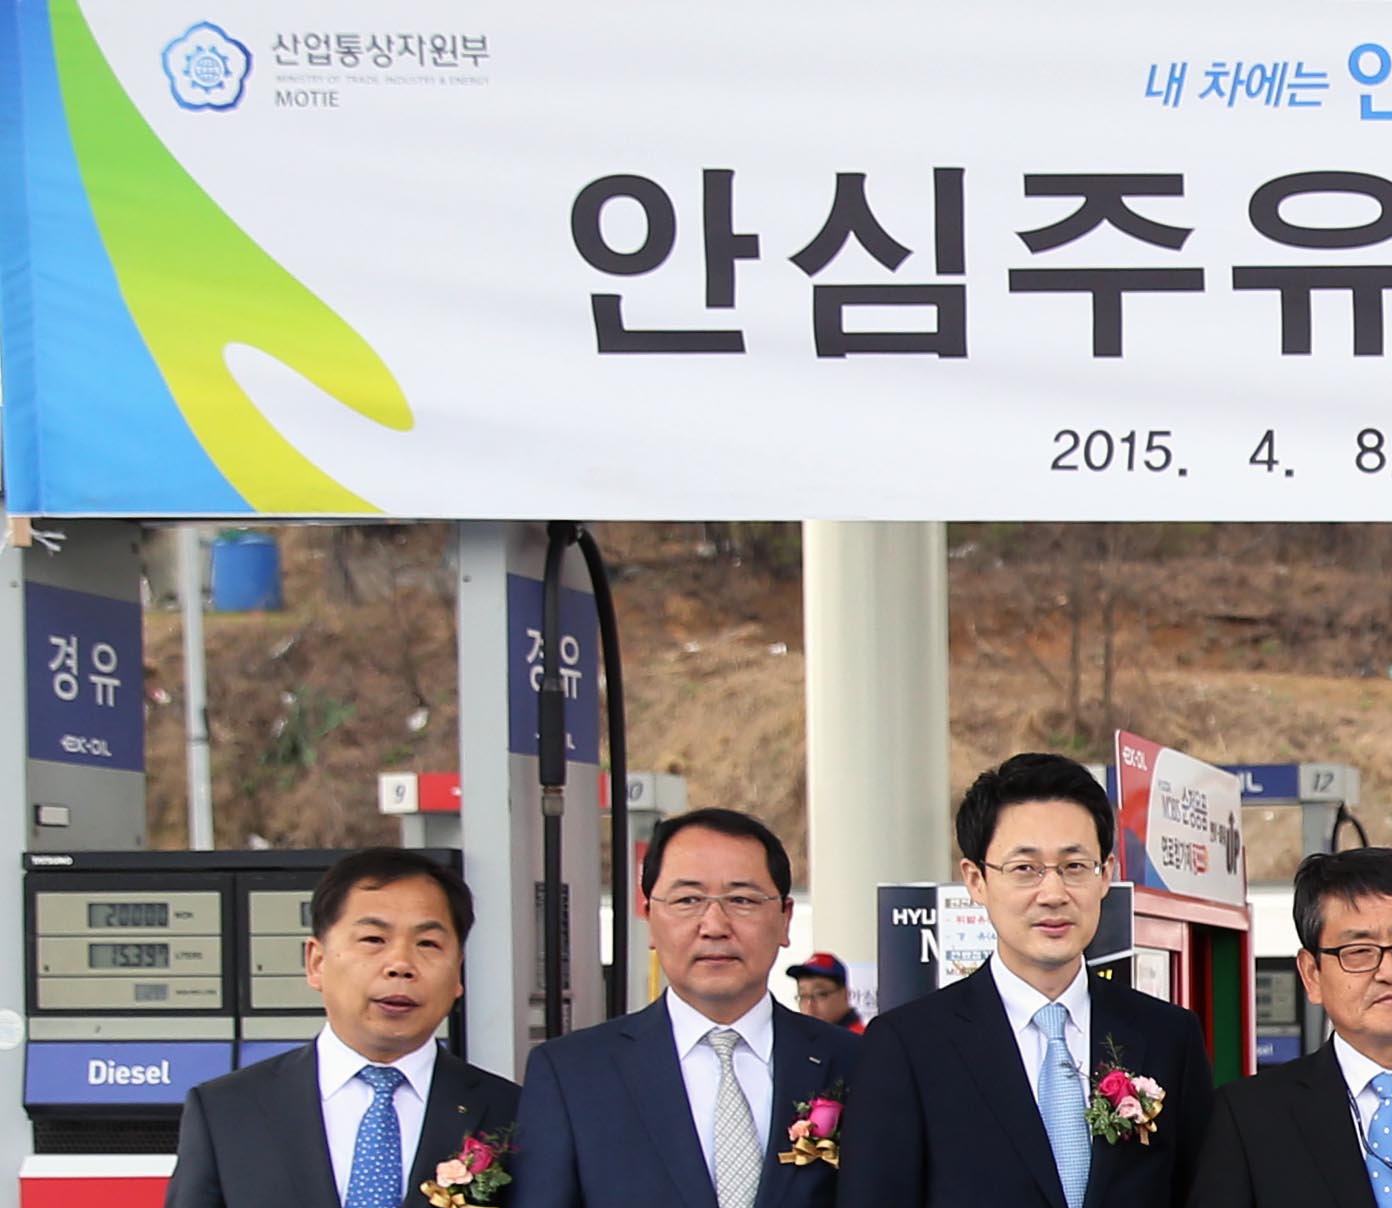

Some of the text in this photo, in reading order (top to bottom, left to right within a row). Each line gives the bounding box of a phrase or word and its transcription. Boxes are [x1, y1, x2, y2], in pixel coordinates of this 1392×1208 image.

[272, 33, 489, 68] 산업통상자원부
[274, 90, 339, 107] MOTIE
[1145, 62, 1187, 107] 내
[1199, 62, 1329, 107] 차에는
[1051, 430, 1187, 476] 2015.
[1250, 430, 1293, 477] 4.
[48, 635, 121, 707] 경유
[628, 783, 643, 800] 0
[1313, 772, 1334, 792] 12
[88, 1059, 171, 1085] Diesel
